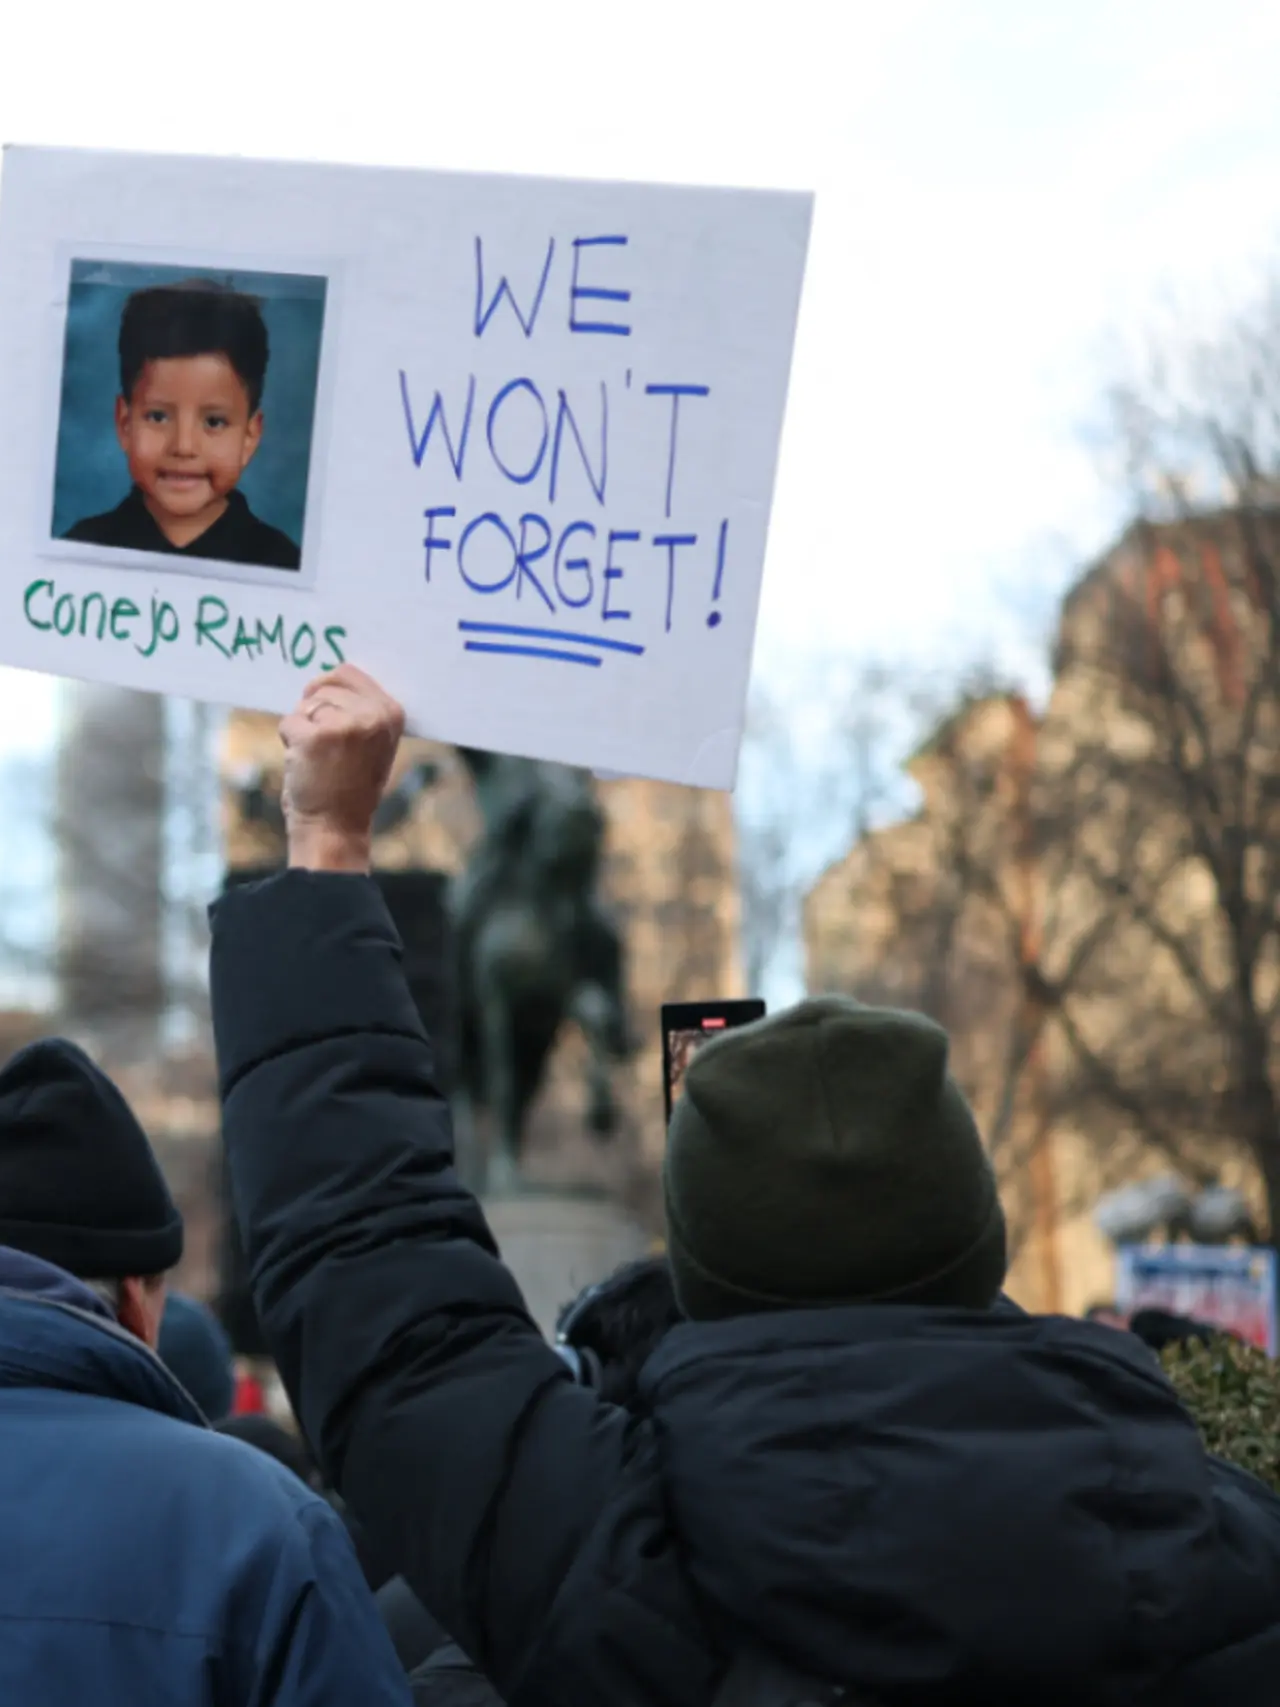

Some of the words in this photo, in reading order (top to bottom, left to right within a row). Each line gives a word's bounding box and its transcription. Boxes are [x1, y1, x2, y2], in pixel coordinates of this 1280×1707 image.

[474, 235, 631, 338] WE
[399, 368, 710, 519] WON'T
[23, 578, 180, 658] Conejo
[194, 594, 347, 672] RAMOS
[423, 506, 729, 633] FORGET!
